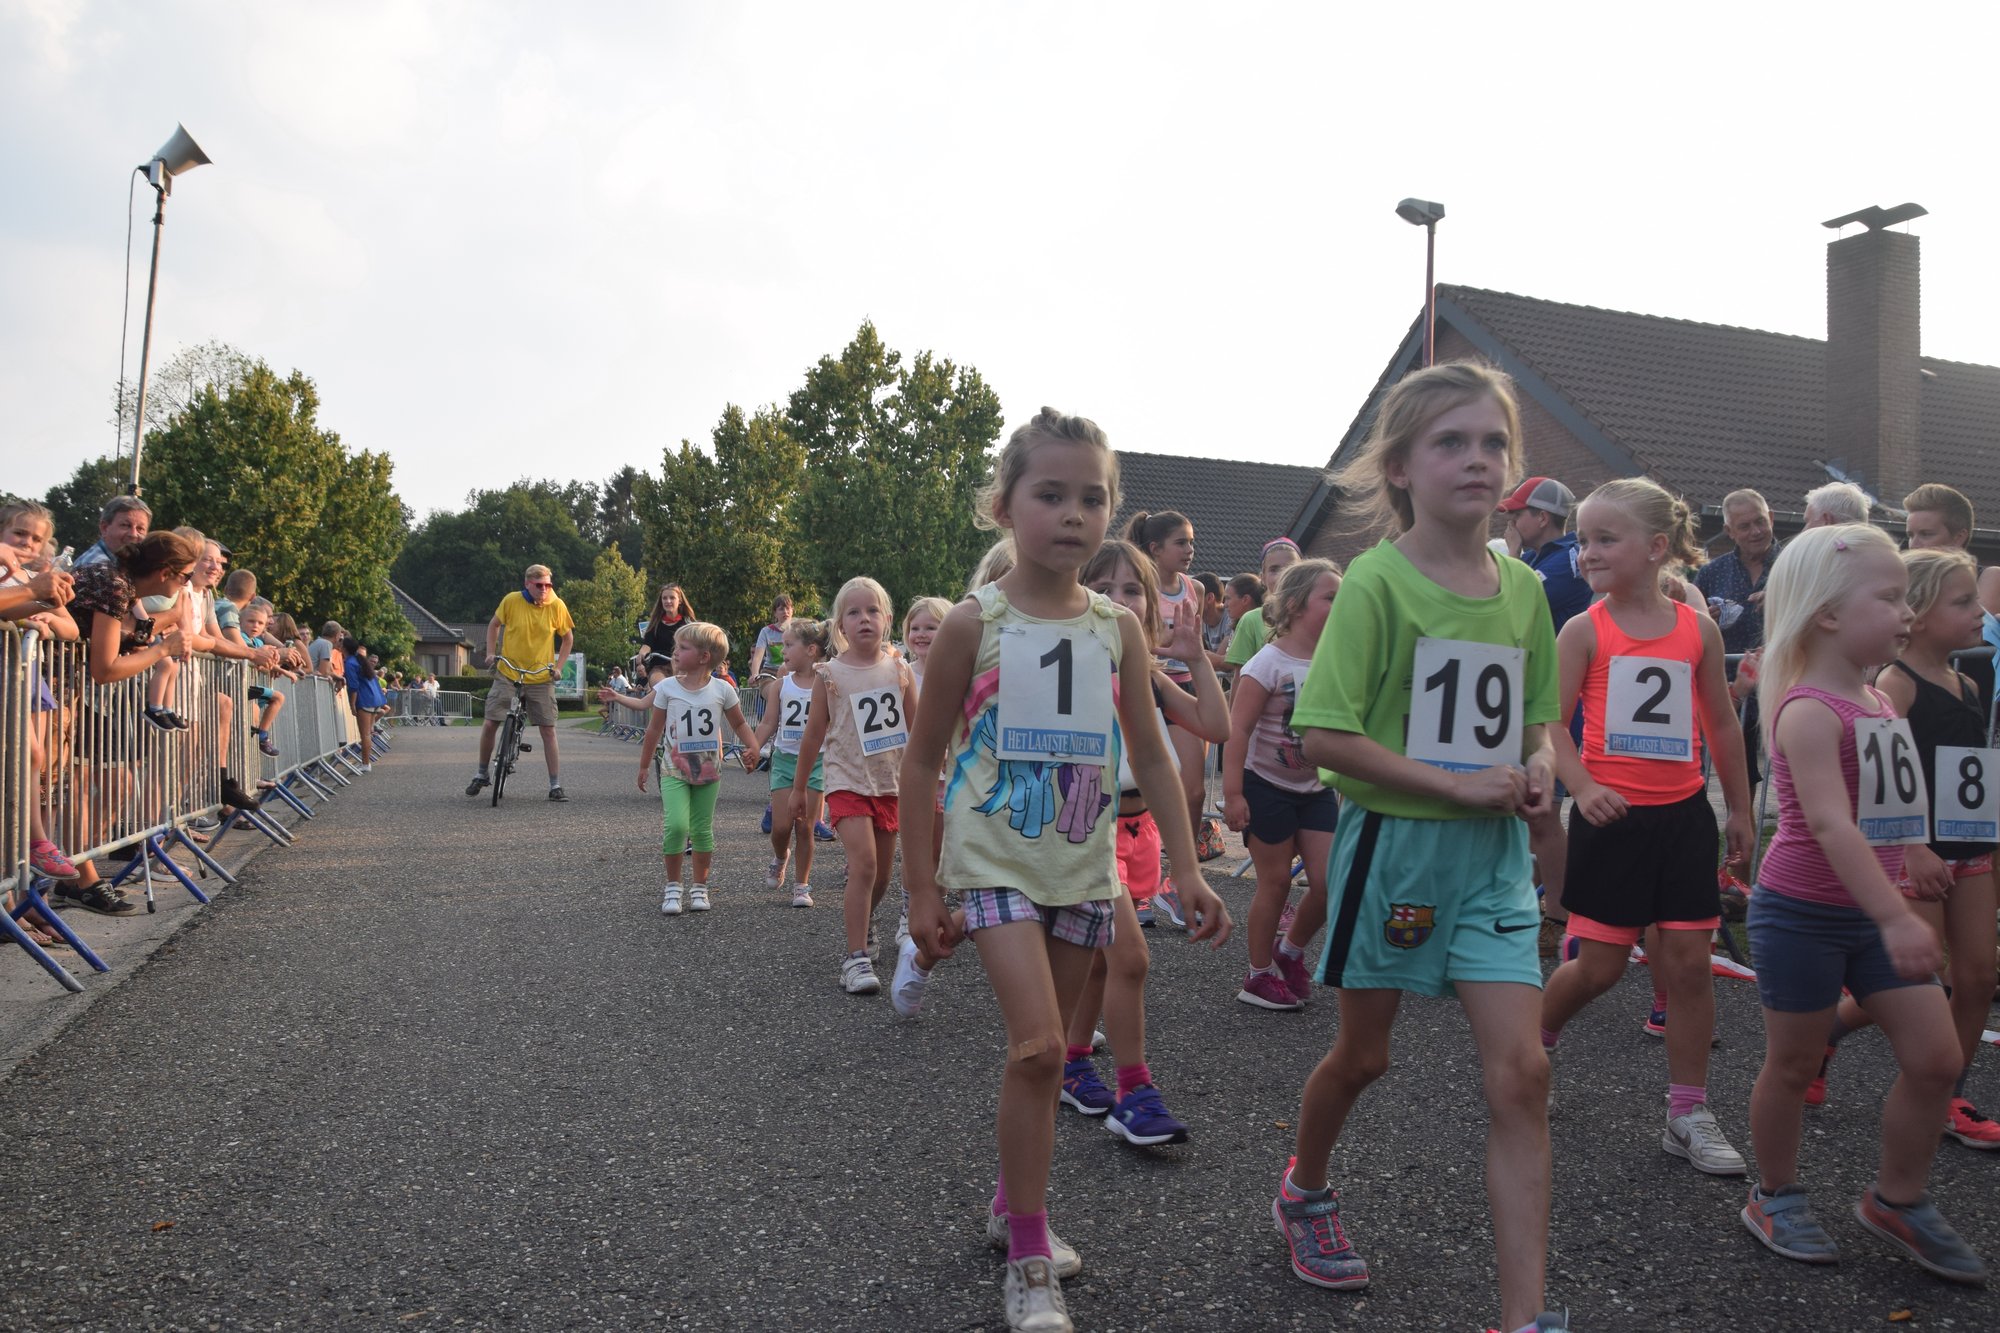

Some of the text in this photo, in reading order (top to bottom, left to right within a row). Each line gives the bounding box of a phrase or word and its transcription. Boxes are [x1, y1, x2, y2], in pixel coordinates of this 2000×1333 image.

[1040, 638, 1073, 715] 1
[1425, 658, 1511, 749] 19
[1632, 666, 1672, 725] 2
[681, 708, 714, 737] 13
[858, 692, 900, 734] 23
[1008, 730, 1102, 755] HET LAATSTE NIEUWS
[1864, 732, 1917, 805] 16
[1957, 755, 1985, 810] 8
